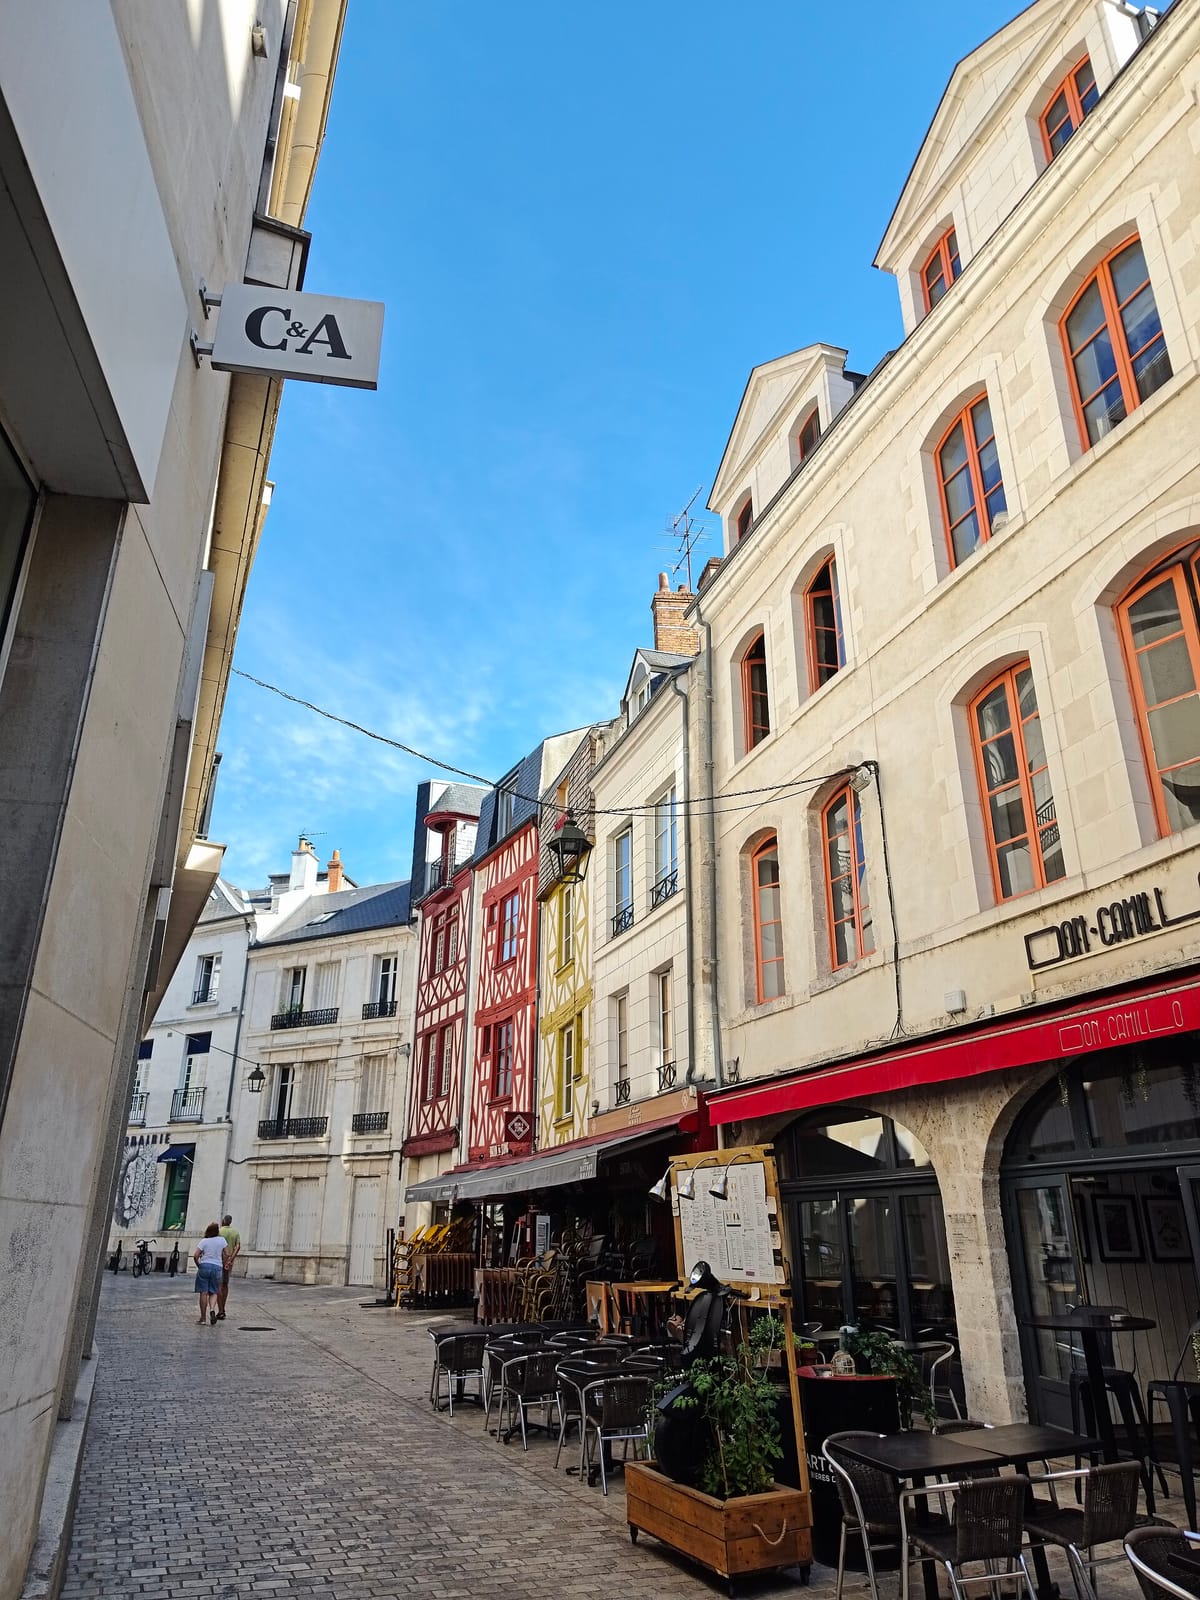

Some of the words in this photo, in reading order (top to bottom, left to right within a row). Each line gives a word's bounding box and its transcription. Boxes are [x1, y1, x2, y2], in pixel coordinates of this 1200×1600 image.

[245, 306, 352, 360] C&A
[1024, 915, 1091, 970] DON
[1097, 872, 1200, 946] CAMILL
[1059, 1020, 1101, 1052] DON
[1108, 1000, 1184, 1041] CAMILLO
